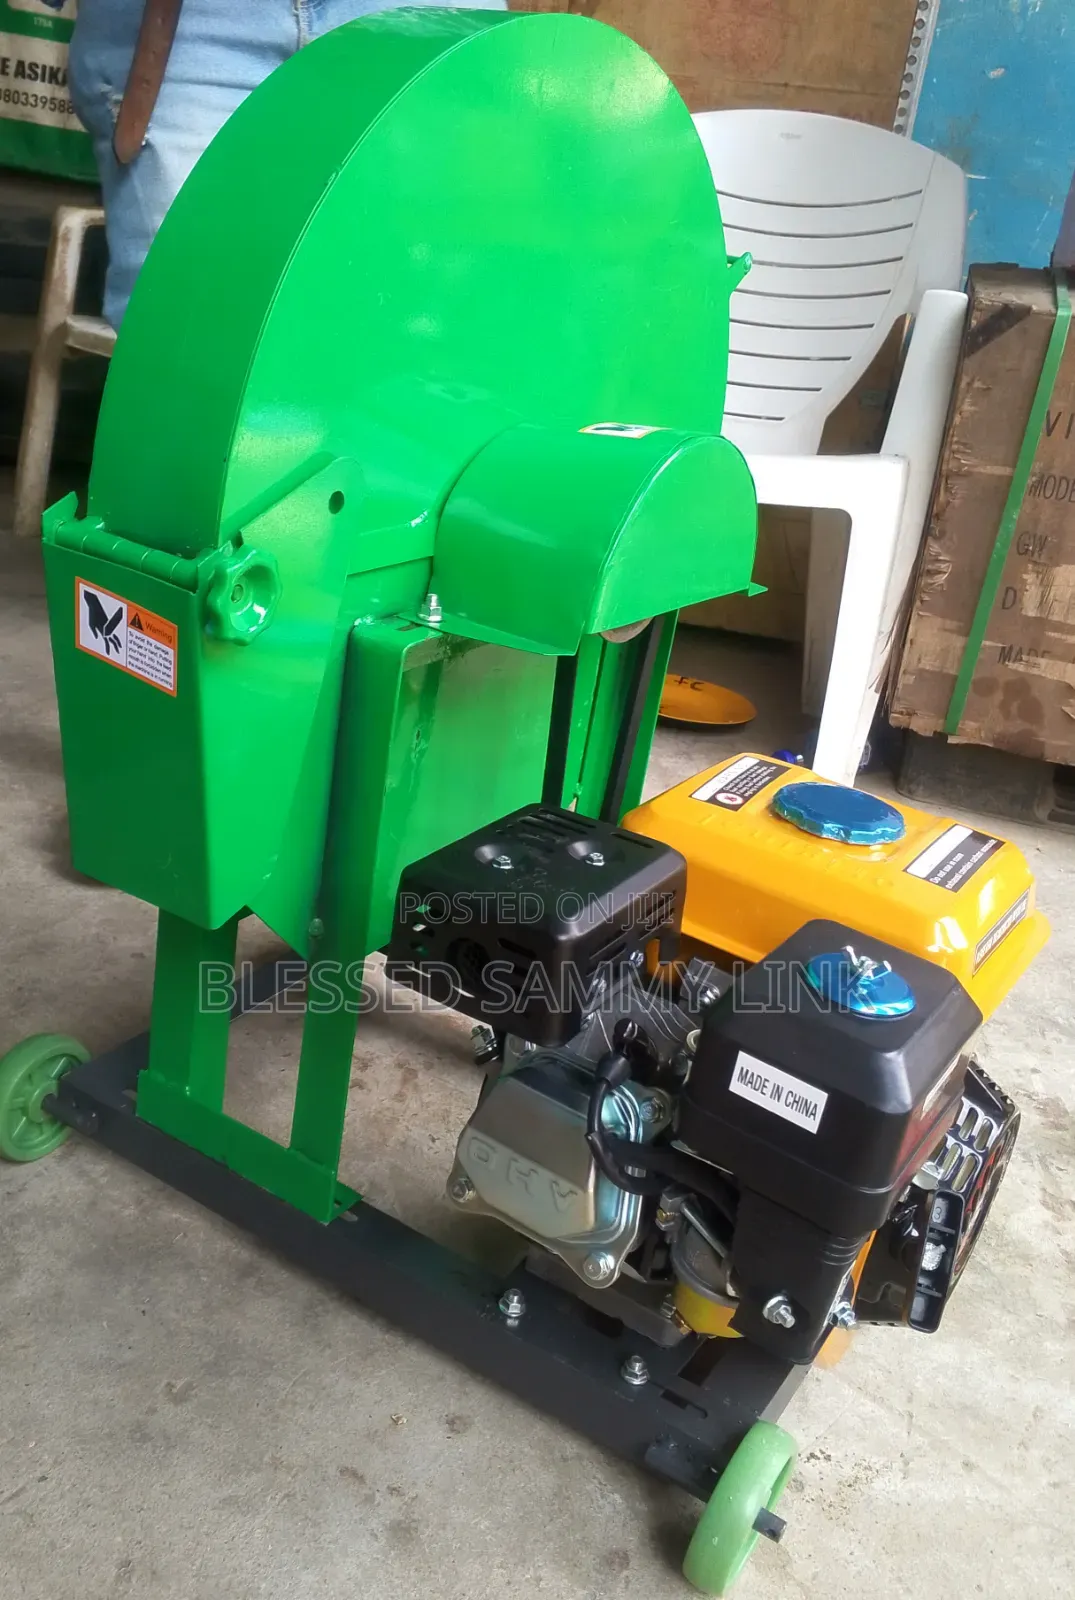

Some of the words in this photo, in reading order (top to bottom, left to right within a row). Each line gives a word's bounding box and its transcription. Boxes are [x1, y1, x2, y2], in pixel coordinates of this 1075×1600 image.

[0, 88, 74, 114] 80339588
[146, 621, 172, 644] Warning
[737, 1066, 770, 1096] MADE
[770, 1082, 784, 1102] IN
[784, 1090, 818, 1121] CHINA
